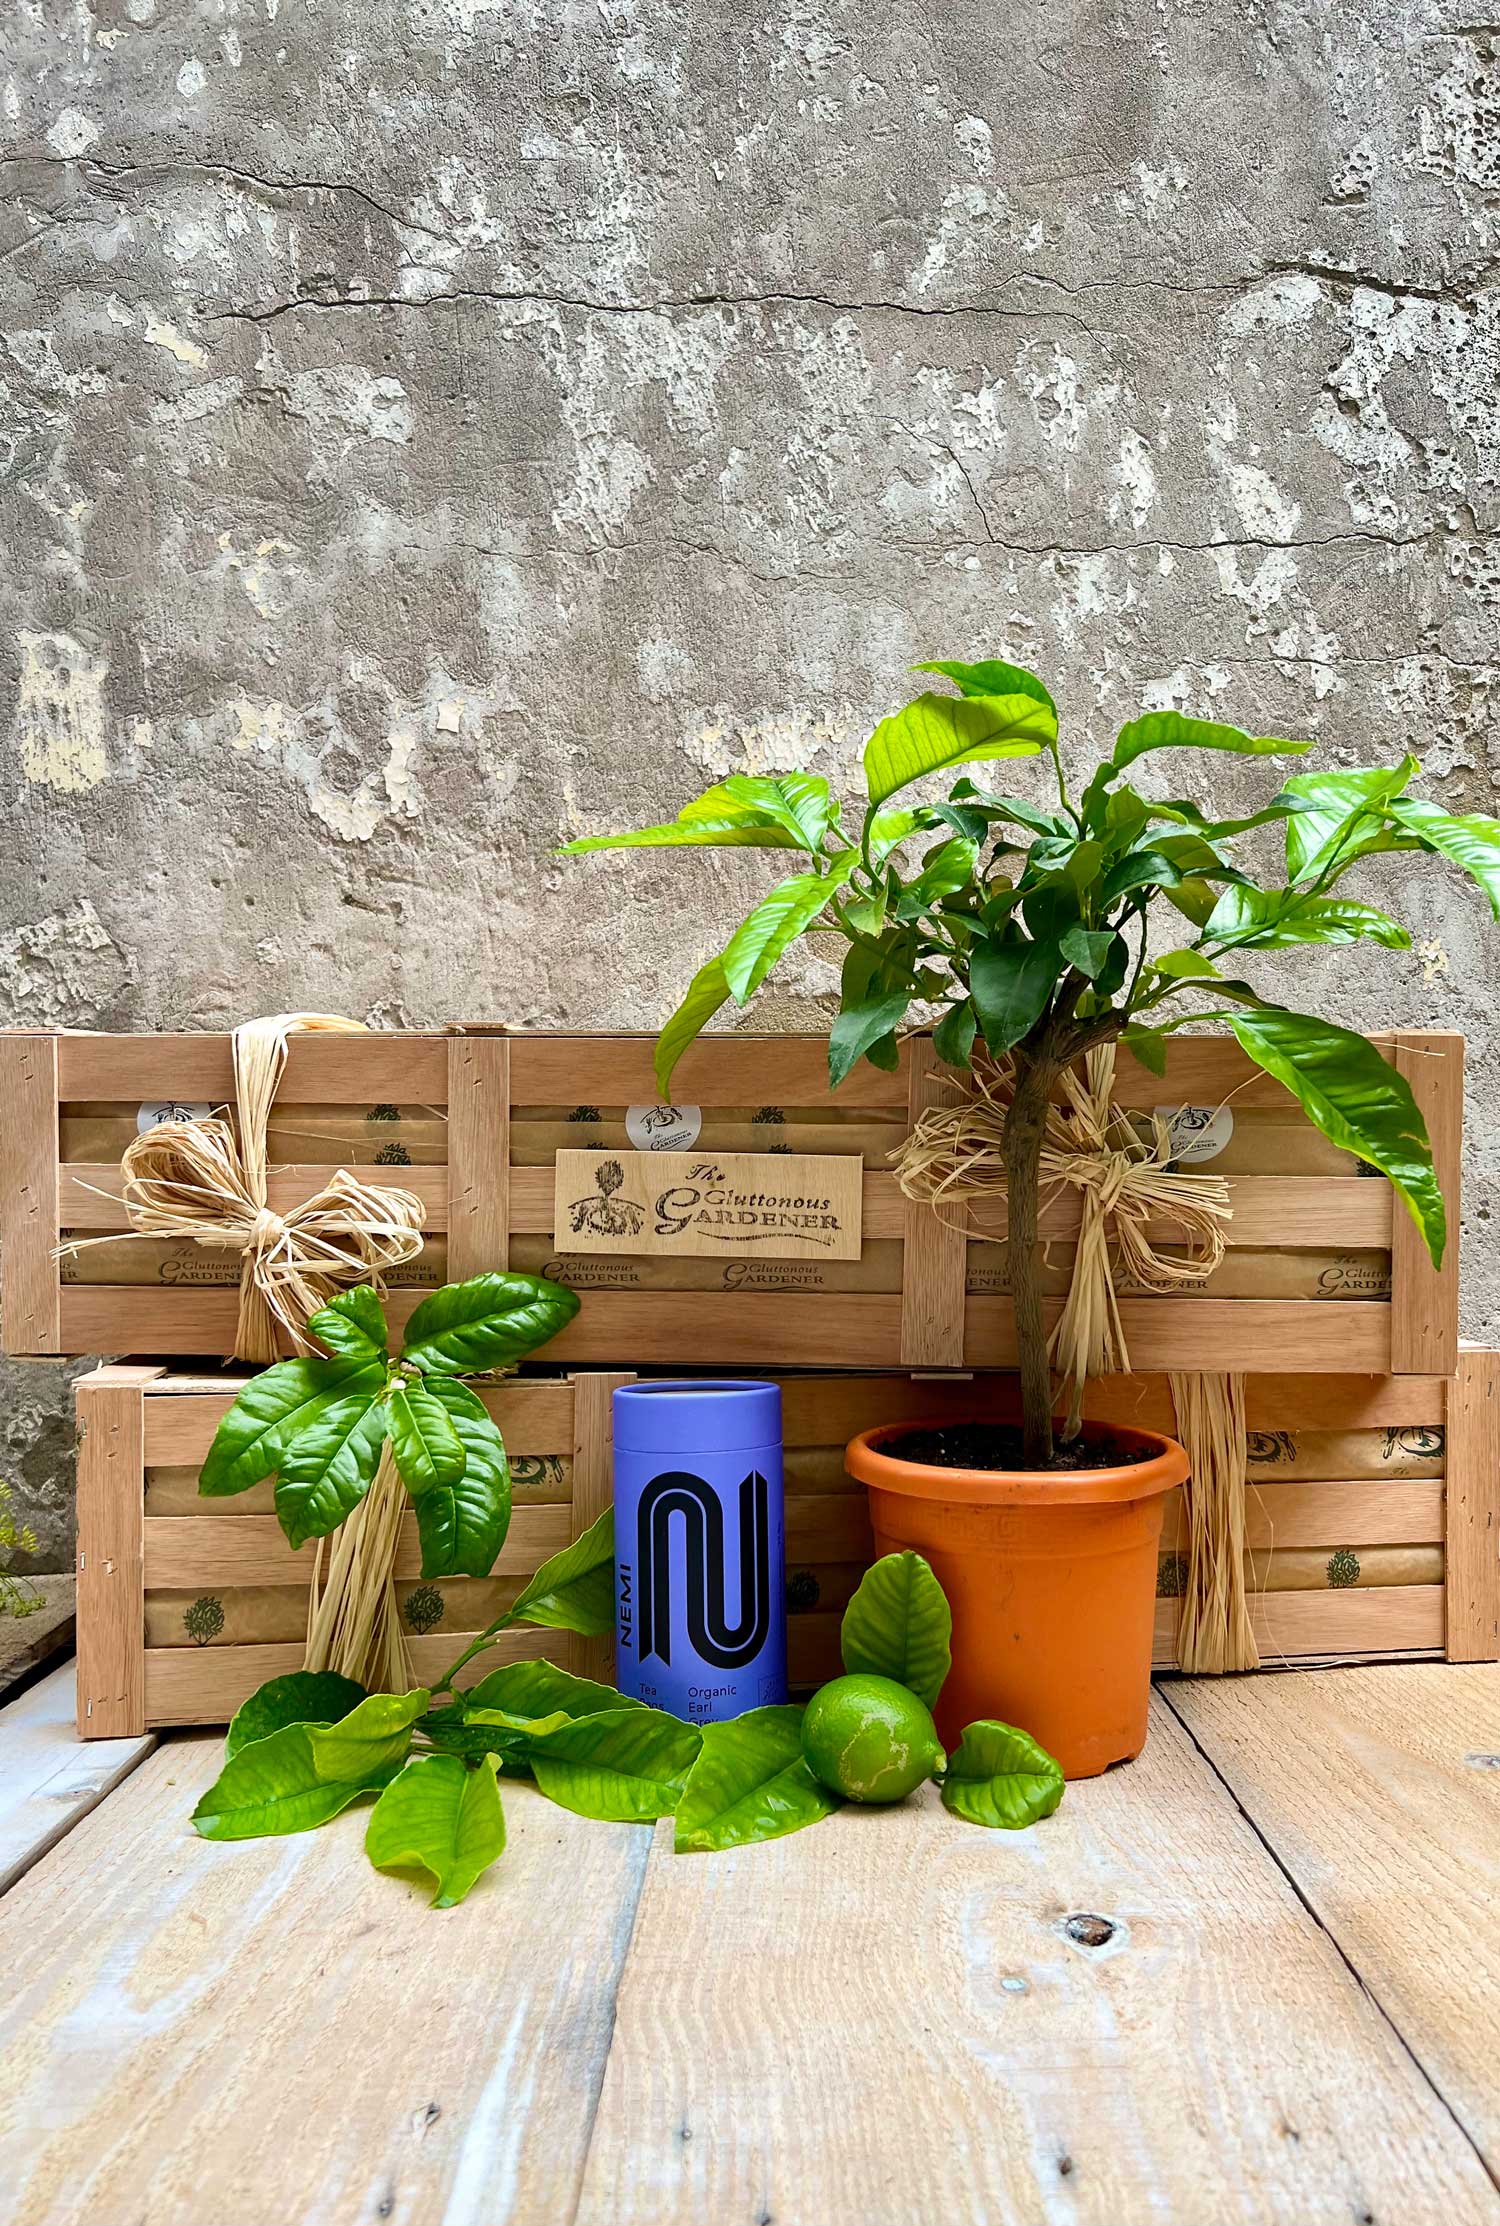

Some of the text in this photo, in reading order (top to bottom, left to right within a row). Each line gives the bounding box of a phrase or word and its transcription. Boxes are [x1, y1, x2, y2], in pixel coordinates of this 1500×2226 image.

[685, 1163, 727, 1182] The
[703, 1189, 831, 1210] Gluttonous
[654, 1187, 842, 1235] GARDENER
[159, 1260, 242, 1285] GARDENE
[383, 1272, 438, 1281] DENER
[543, 1261, 641, 1283] GARDENER
[565, 1262, 634, 1273] Gluttonous
[722, 1263, 825, 1290] GARDENER
[748, 1263, 819, 1274] Gluttonous
[1316, 1267, 1392, 1296] GARDE
[619, 1563, 633, 1648] NEMI
[639, 1683, 657, 1696] Tea
[688, 1684, 737, 1700] Organic
[688, 1702, 713, 1714] Earl
